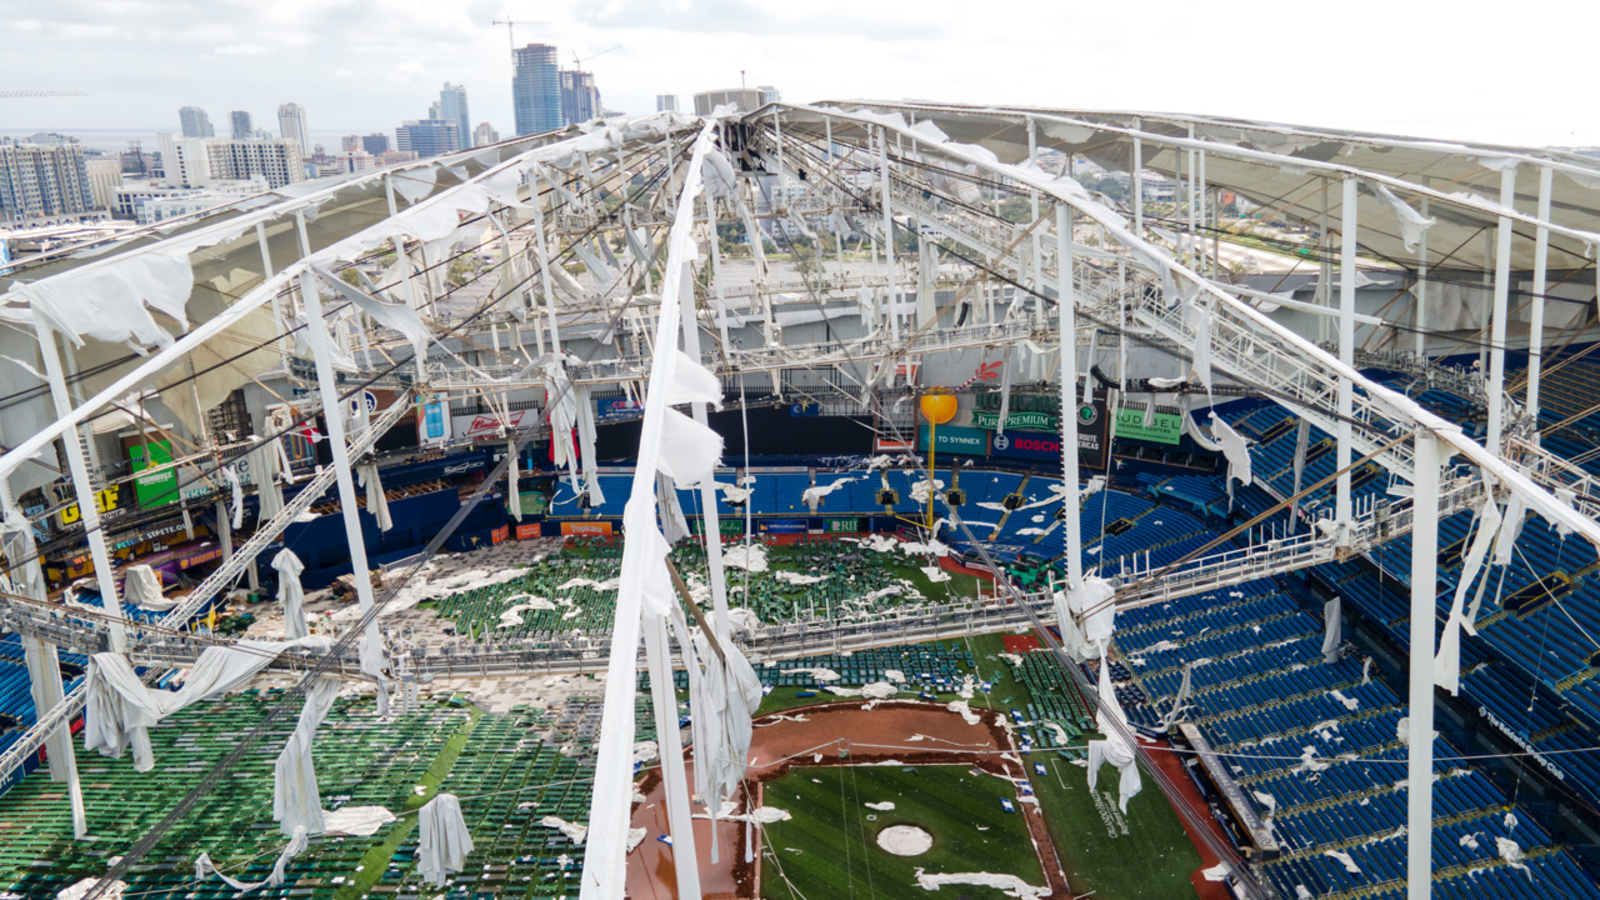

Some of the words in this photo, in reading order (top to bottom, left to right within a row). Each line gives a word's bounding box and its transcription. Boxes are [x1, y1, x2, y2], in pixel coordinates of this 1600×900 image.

[1005, 415, 1049, 426] PREMIUM
[1119, 422, 1143, 431] HEARING
[1145, 426, 1170, 434] CENTERS
[938, 435, 948, 443] TD
[950, 436, 980, 445] SYNNEX
[1014, 438, 1060, 452] BOSCH
[570, 524, 602, 534] Tropicana
[116, 538, 135, 549] PETE
[73, 555, 87, 564] WE
[1487, 712, 1499, 727] The
[1499, 722, 1526, 749] Baldwin
[1526, 744, 1547, 766] Group
[1547, 762, 1565, 780] Club
[1206, 755, 1231, 788] TROPICANA
[1227, 787, 1237, 797] TO
